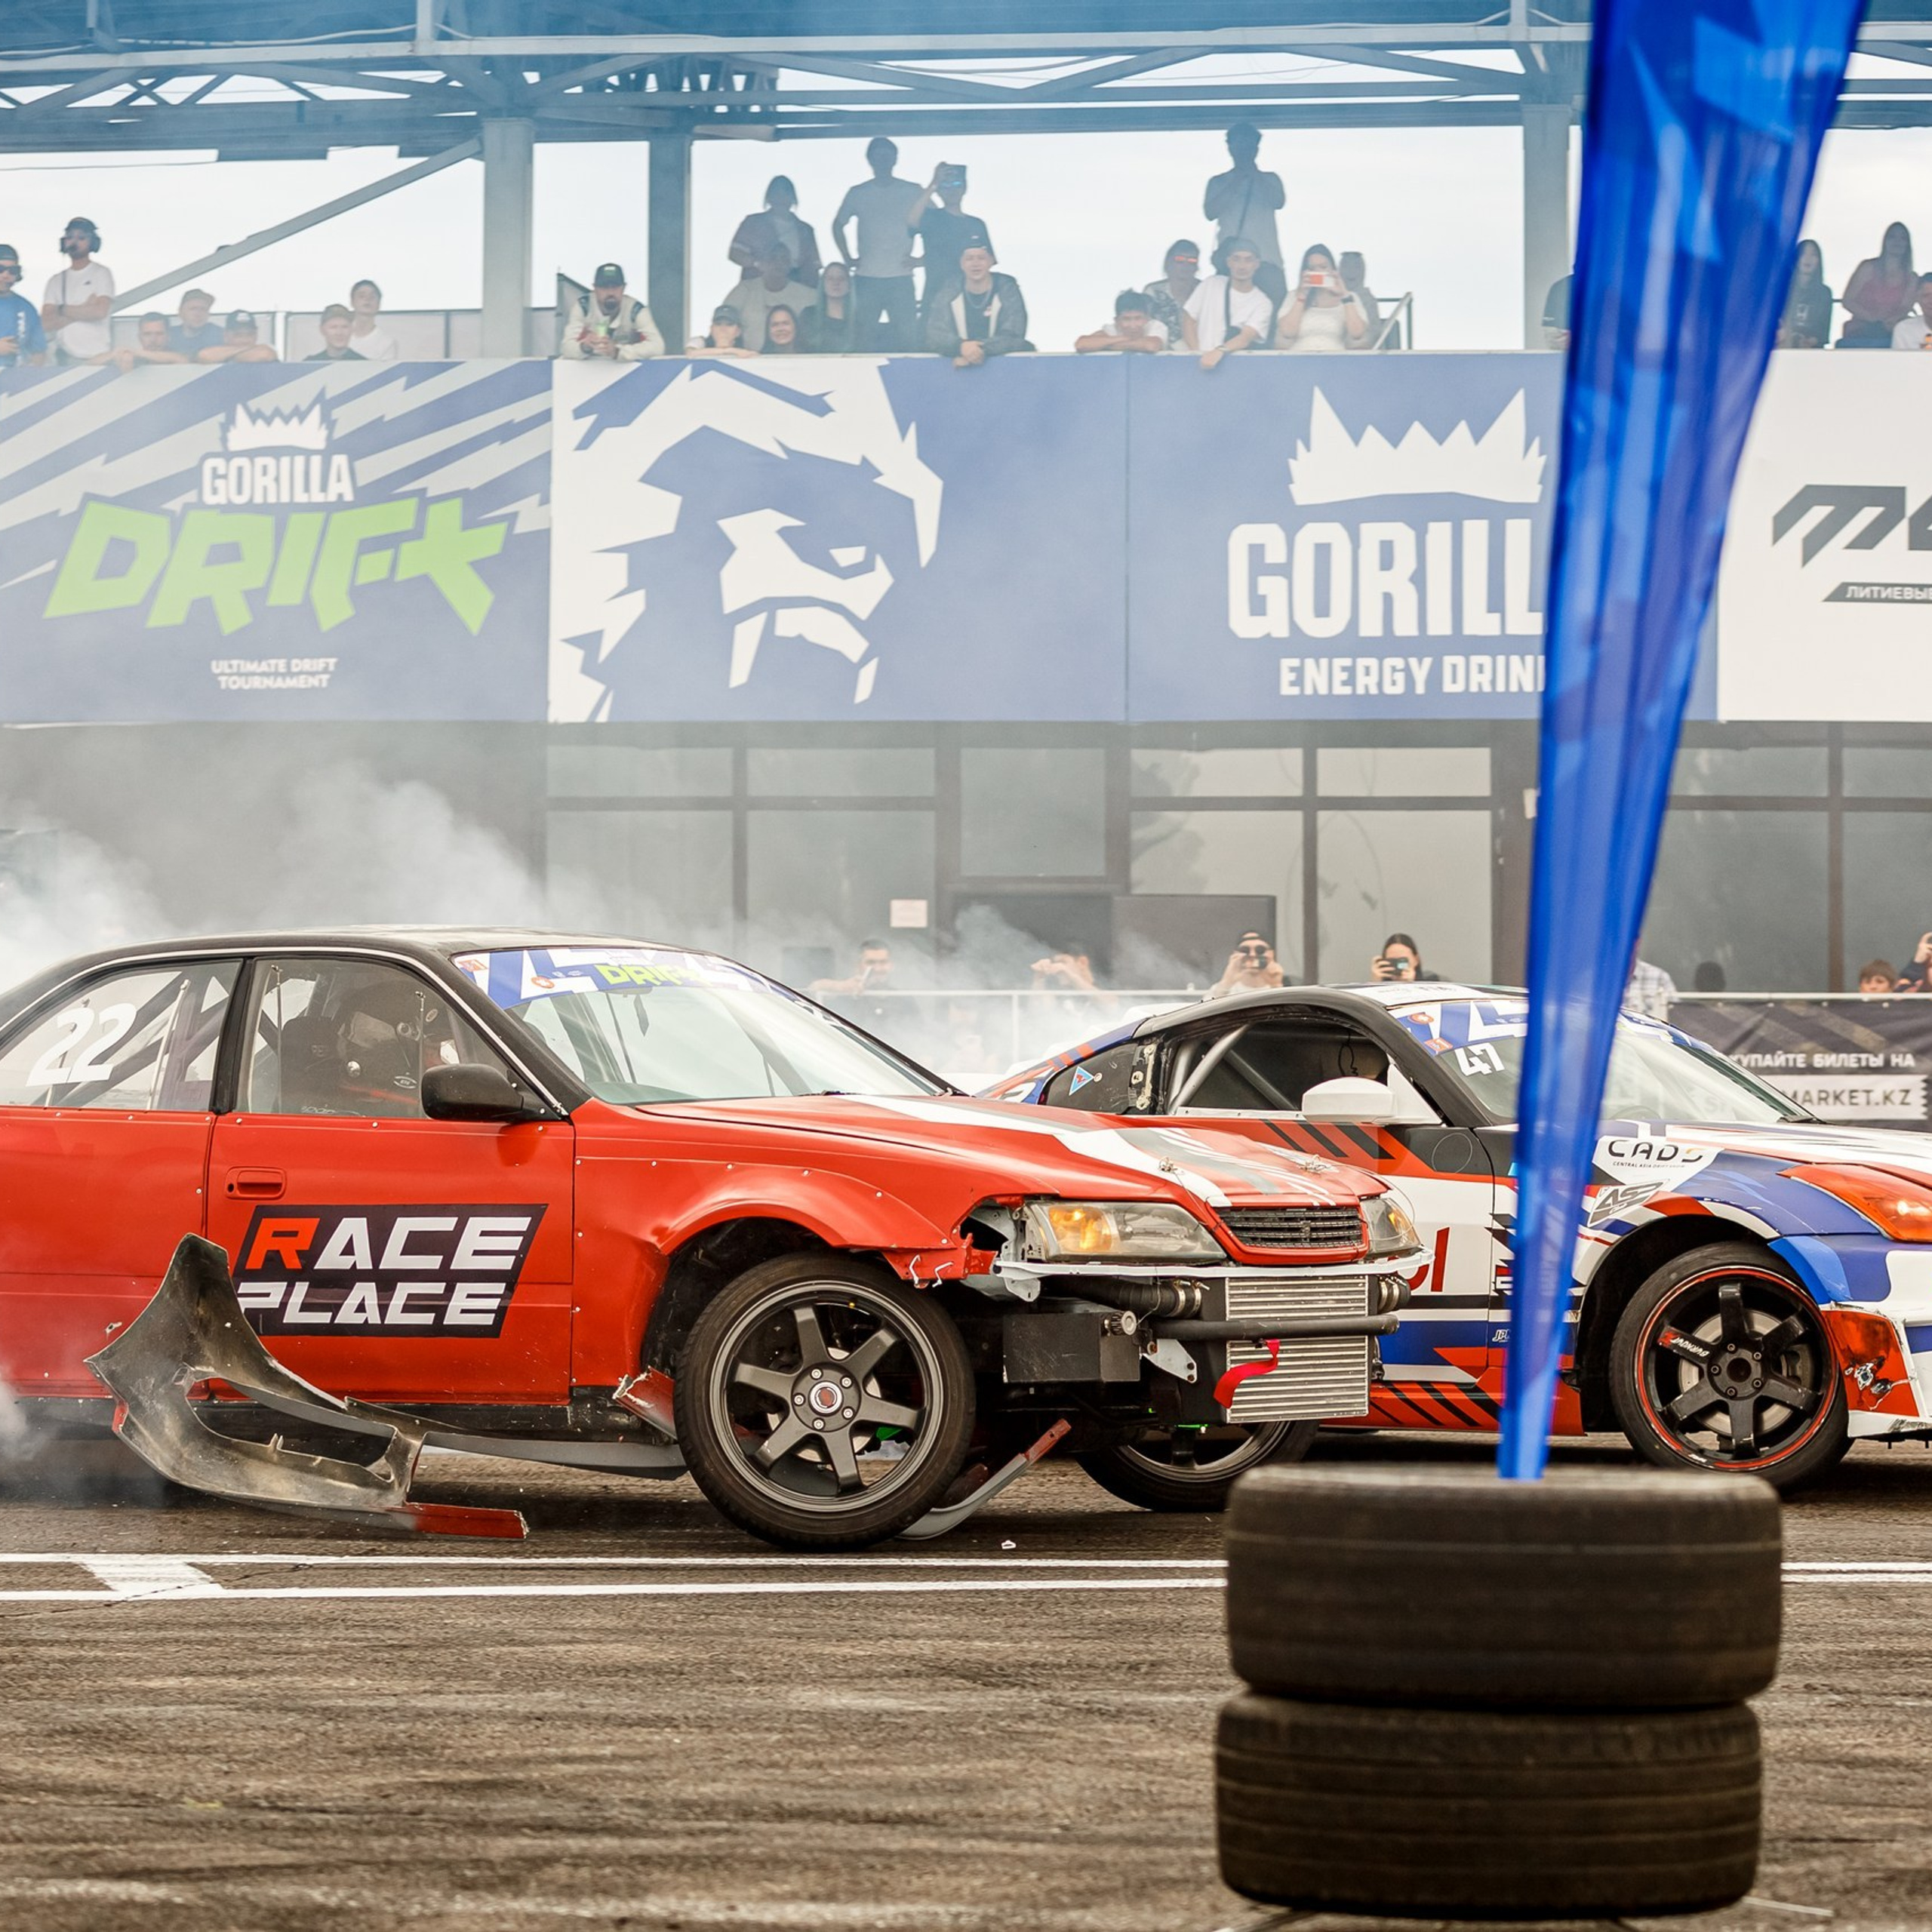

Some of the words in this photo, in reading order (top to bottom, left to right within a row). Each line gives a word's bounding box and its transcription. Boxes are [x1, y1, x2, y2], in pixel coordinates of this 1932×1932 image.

[202, 454, 354, 504] GORILLA
[42, 497, 508, 635] DRIFT
[1227, 518, 1544, 639] GORILL
[211, 659, 288, 674] ULTIMATE
[291, 657, 337, 673] DRIFT
[217, 673, 331, 690] TOURNAMENT
[1279, 657, 1432, 696] ENERGY
[1442, 654, 1545, 693] DRIN
[26, 1003, 138, 1087] 22
[1454, 1041, 1505, 1076] 47
[1813, 1053, 1884, 1069] БИЛЕТЫ
[1890, 1053, 1915, 1069] НА
[1607, 1139, 1703, 1162] CADS
[245, 1217, 532, 1270] RACE
[236, 1281, 506, 1325] PLACE
[1669, 1336, 1711, 1357] BURNOUT
